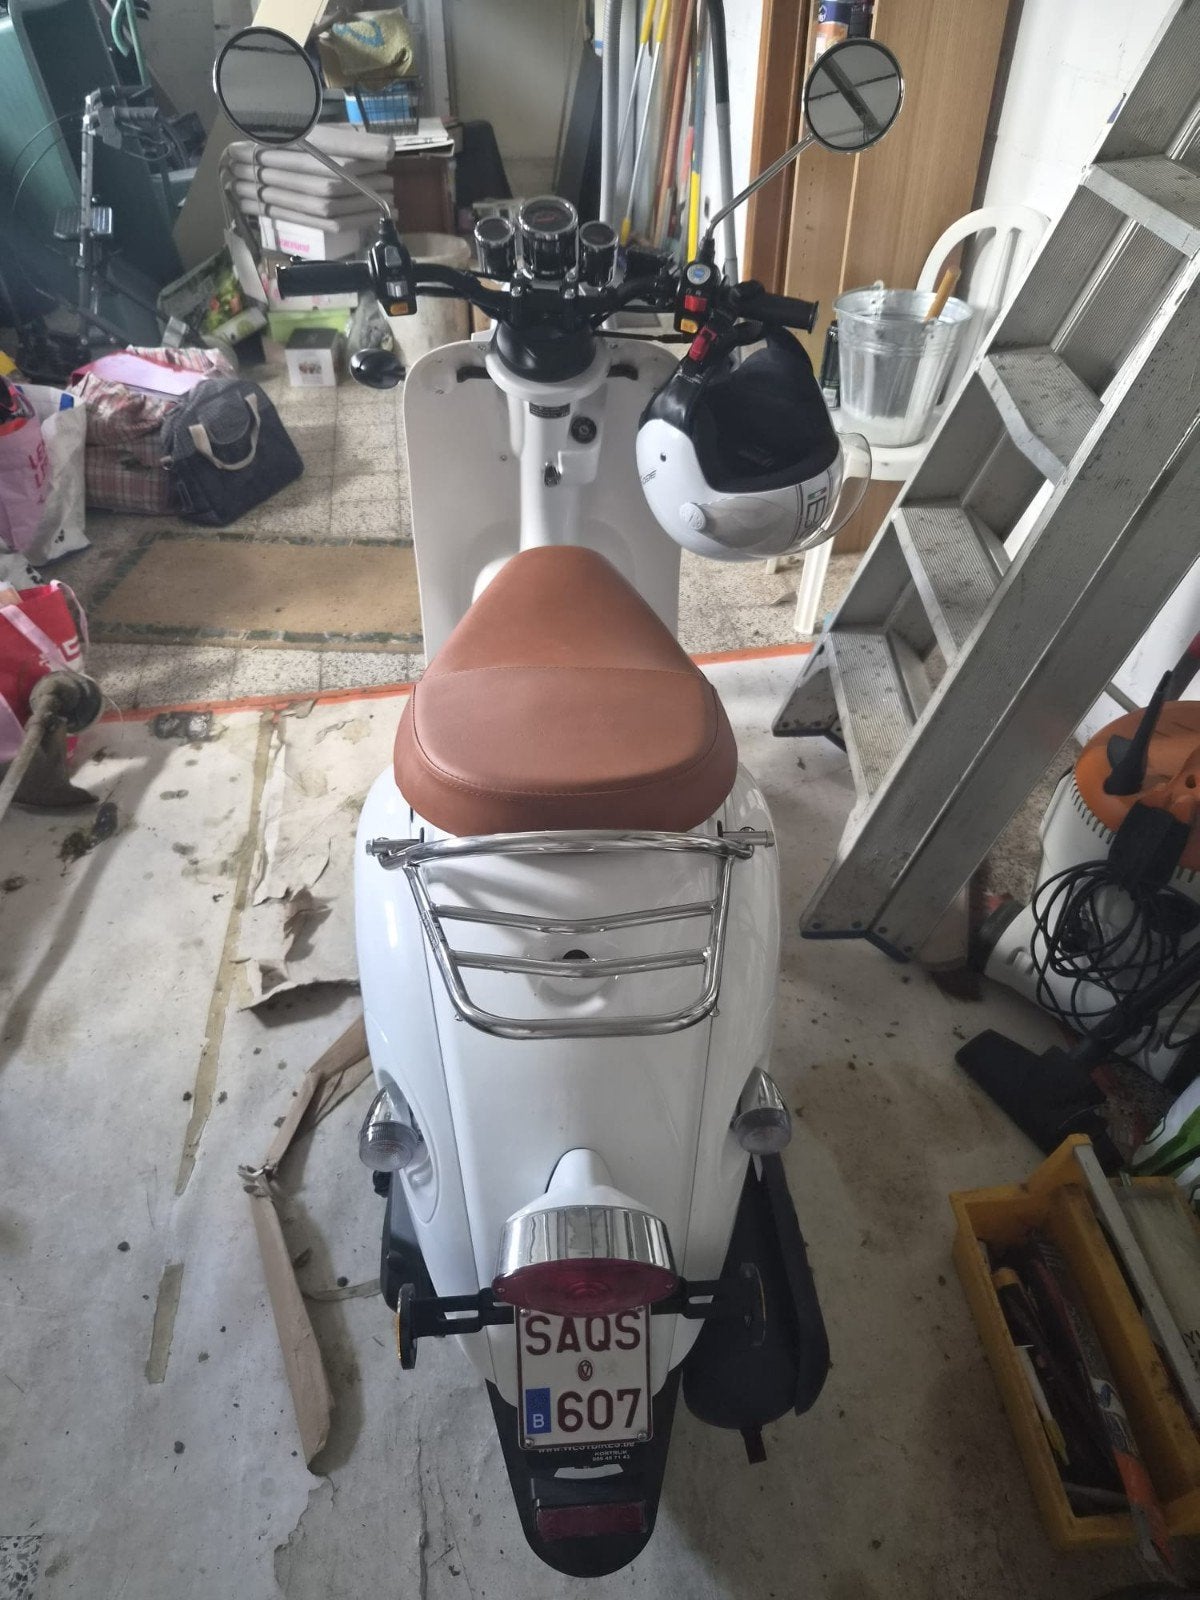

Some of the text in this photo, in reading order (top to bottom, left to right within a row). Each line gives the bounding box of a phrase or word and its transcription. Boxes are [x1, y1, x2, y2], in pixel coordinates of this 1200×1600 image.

[525, 1310, 641, 1355] SAQS
[533, 1414, 544, 1428] B
[557, 1388, 642, 1432] 607
